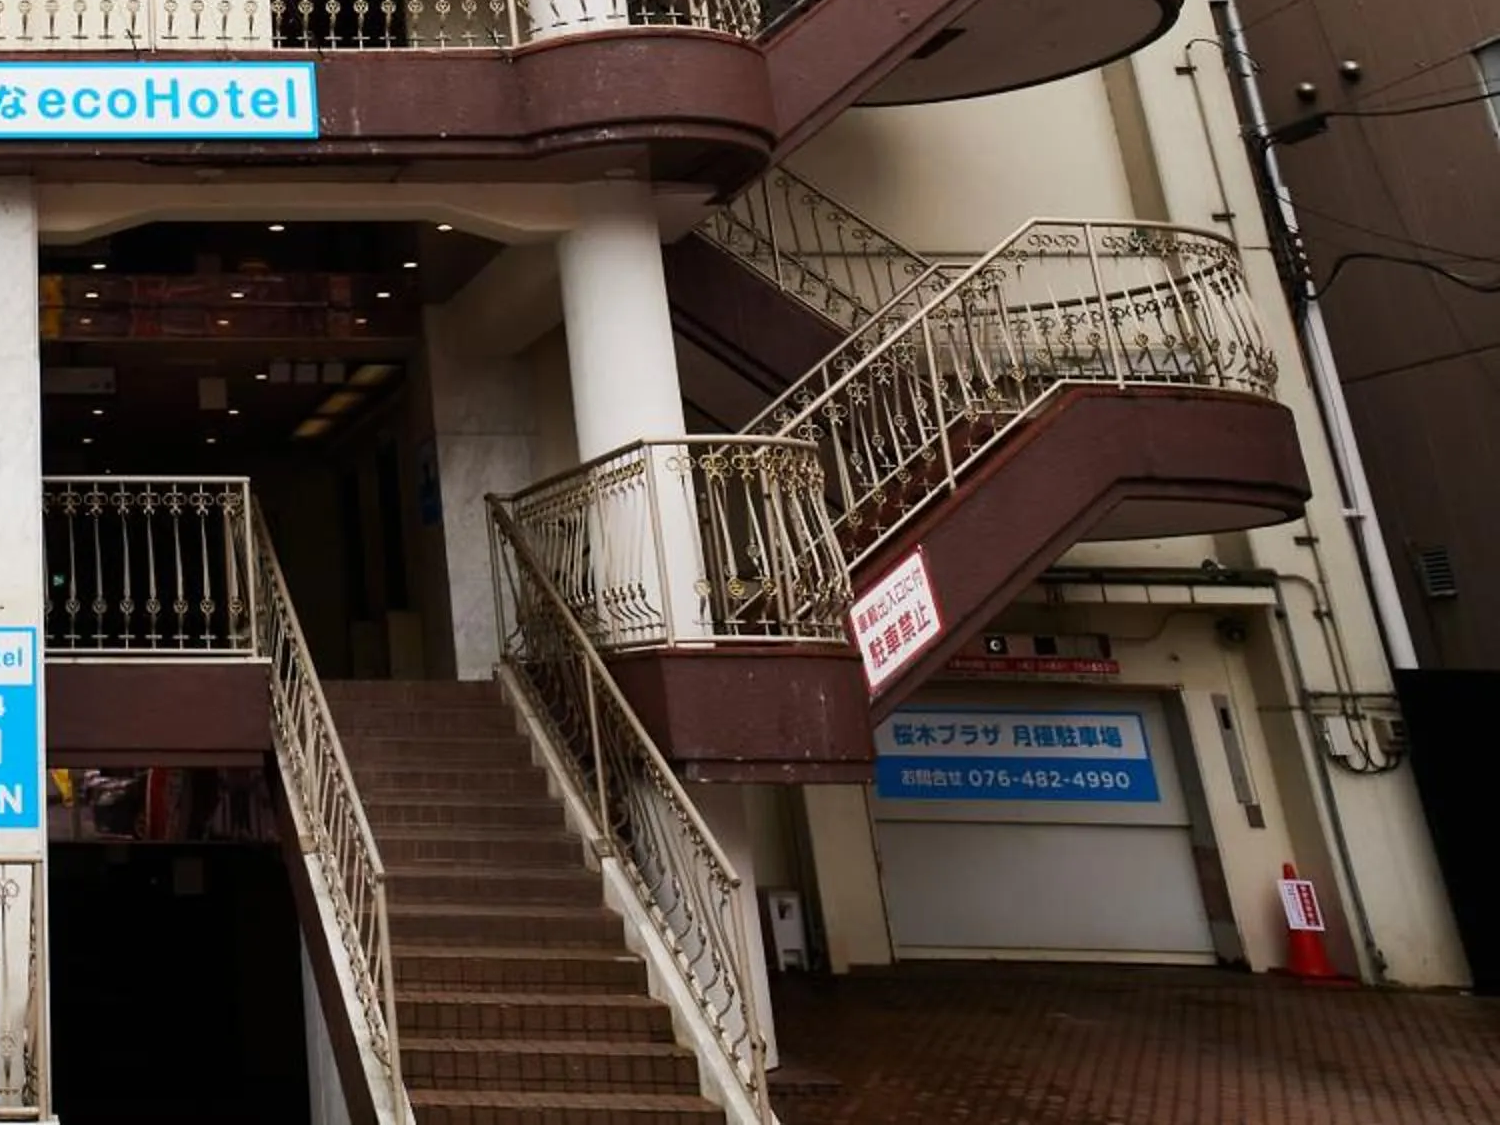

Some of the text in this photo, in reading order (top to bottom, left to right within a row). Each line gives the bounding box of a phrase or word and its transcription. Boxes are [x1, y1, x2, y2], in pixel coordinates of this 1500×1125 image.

[868, 599, 931, 669] 駐車禁止
[892, 722, 1124, 749] 桜木プラザ 月極駐車場
[969, 769, 1131, 791] 076-482-4990
